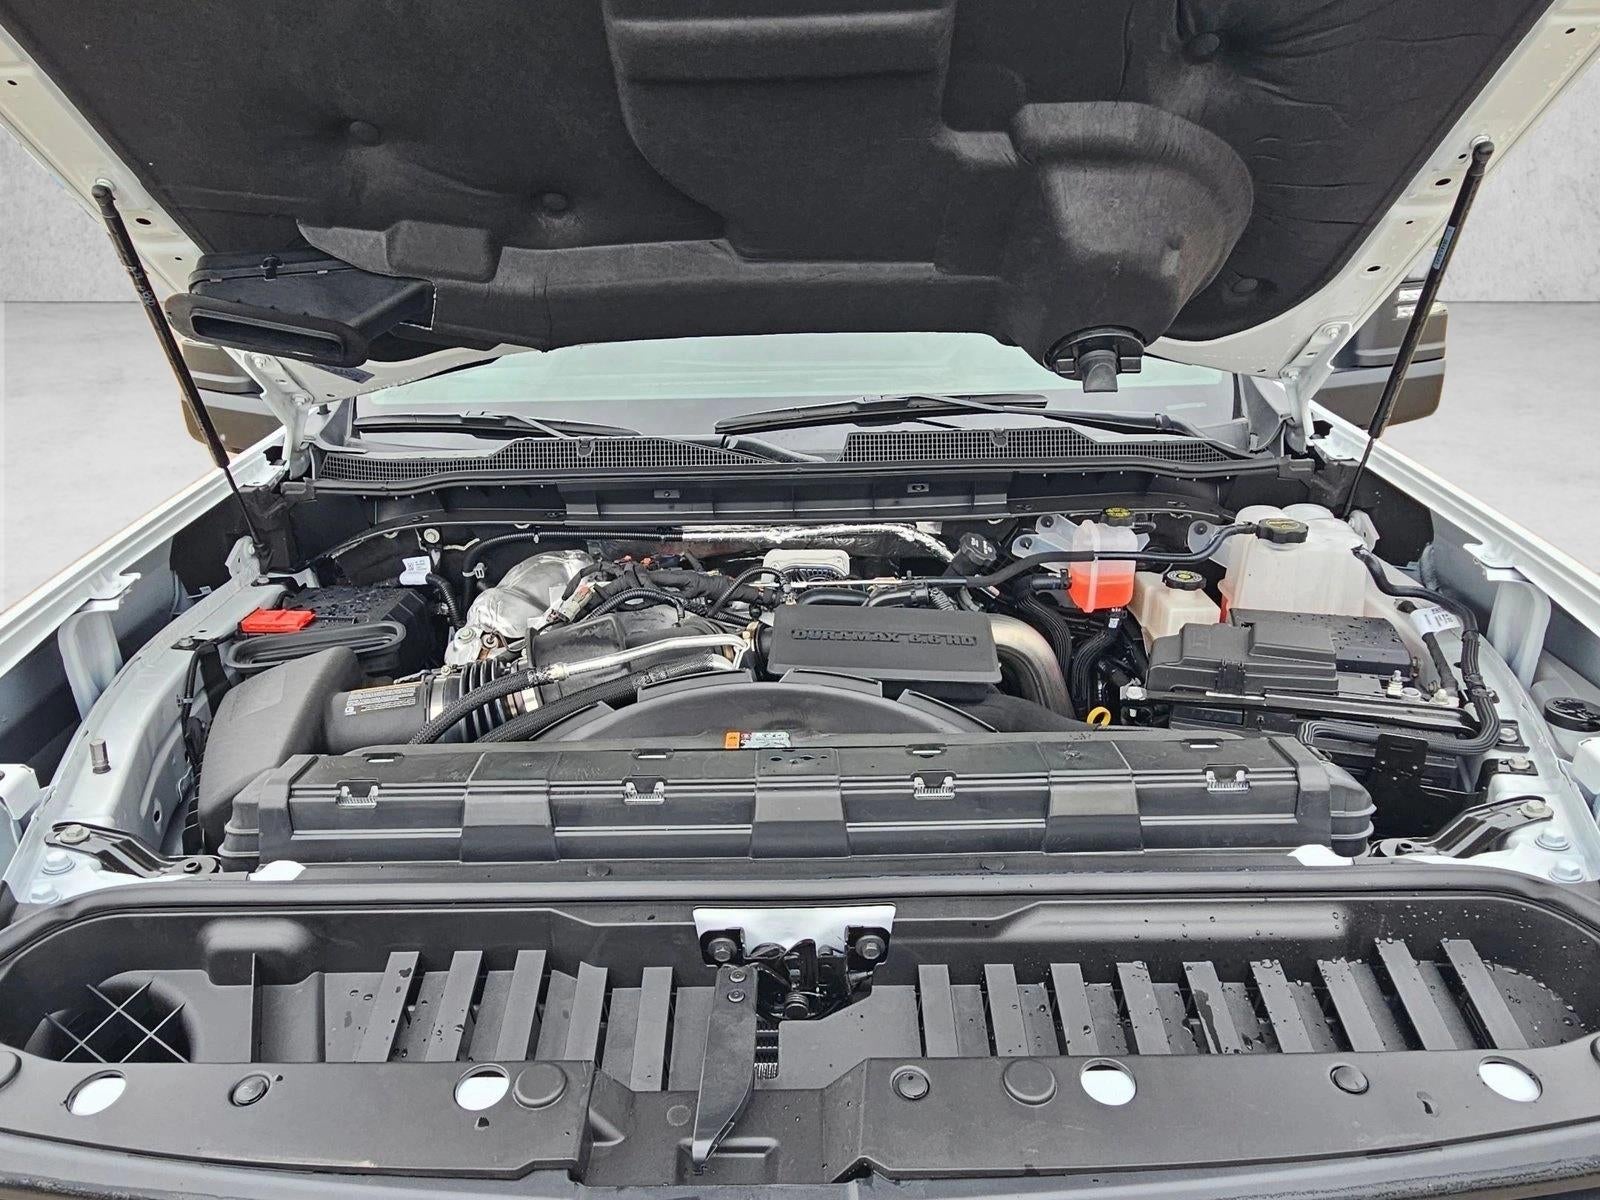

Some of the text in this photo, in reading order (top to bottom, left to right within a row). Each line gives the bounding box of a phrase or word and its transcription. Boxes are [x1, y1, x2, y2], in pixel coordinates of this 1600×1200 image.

[791, 629, 977, 646] DURAMAX 6.6 HD
